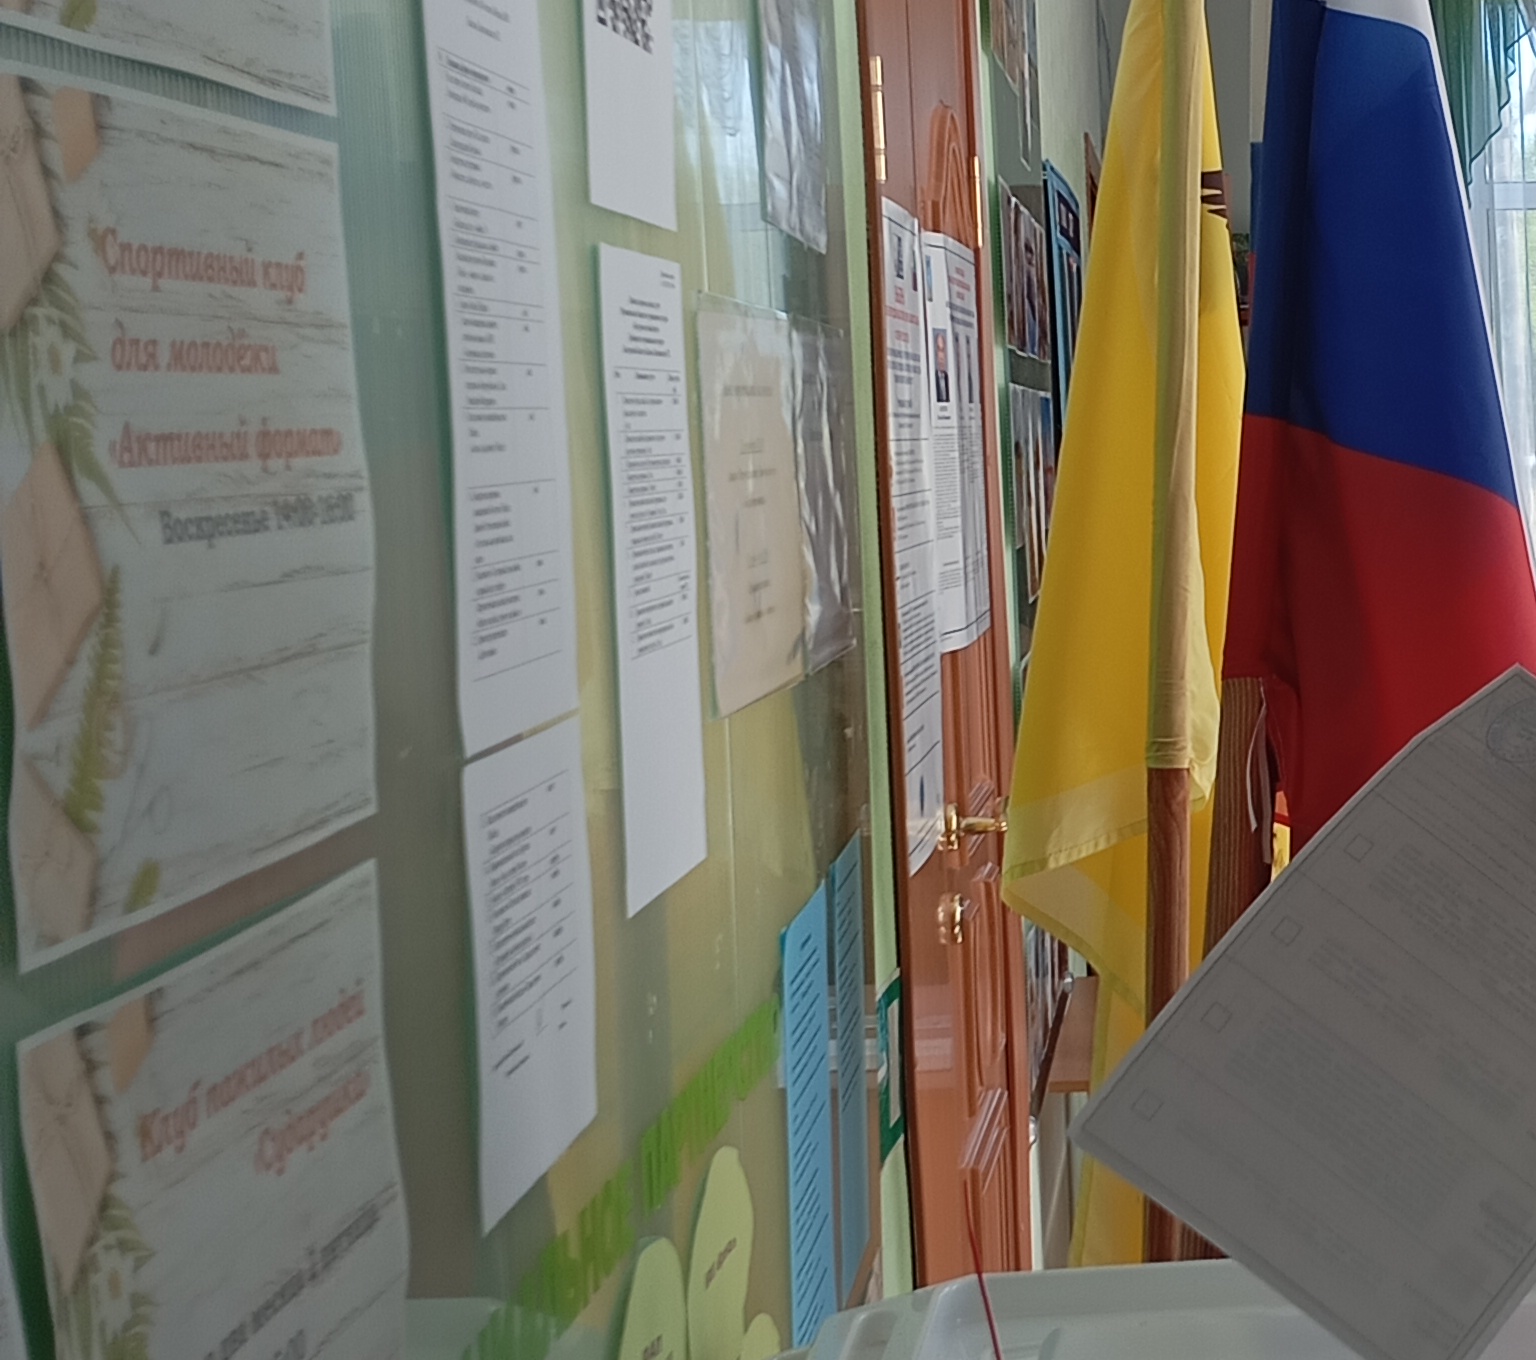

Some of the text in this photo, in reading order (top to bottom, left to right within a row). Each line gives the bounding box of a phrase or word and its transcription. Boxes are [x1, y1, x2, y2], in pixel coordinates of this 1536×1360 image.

[101, 225, 306, 306] Спортивный клуб
[111, 317, 161, 373] для
